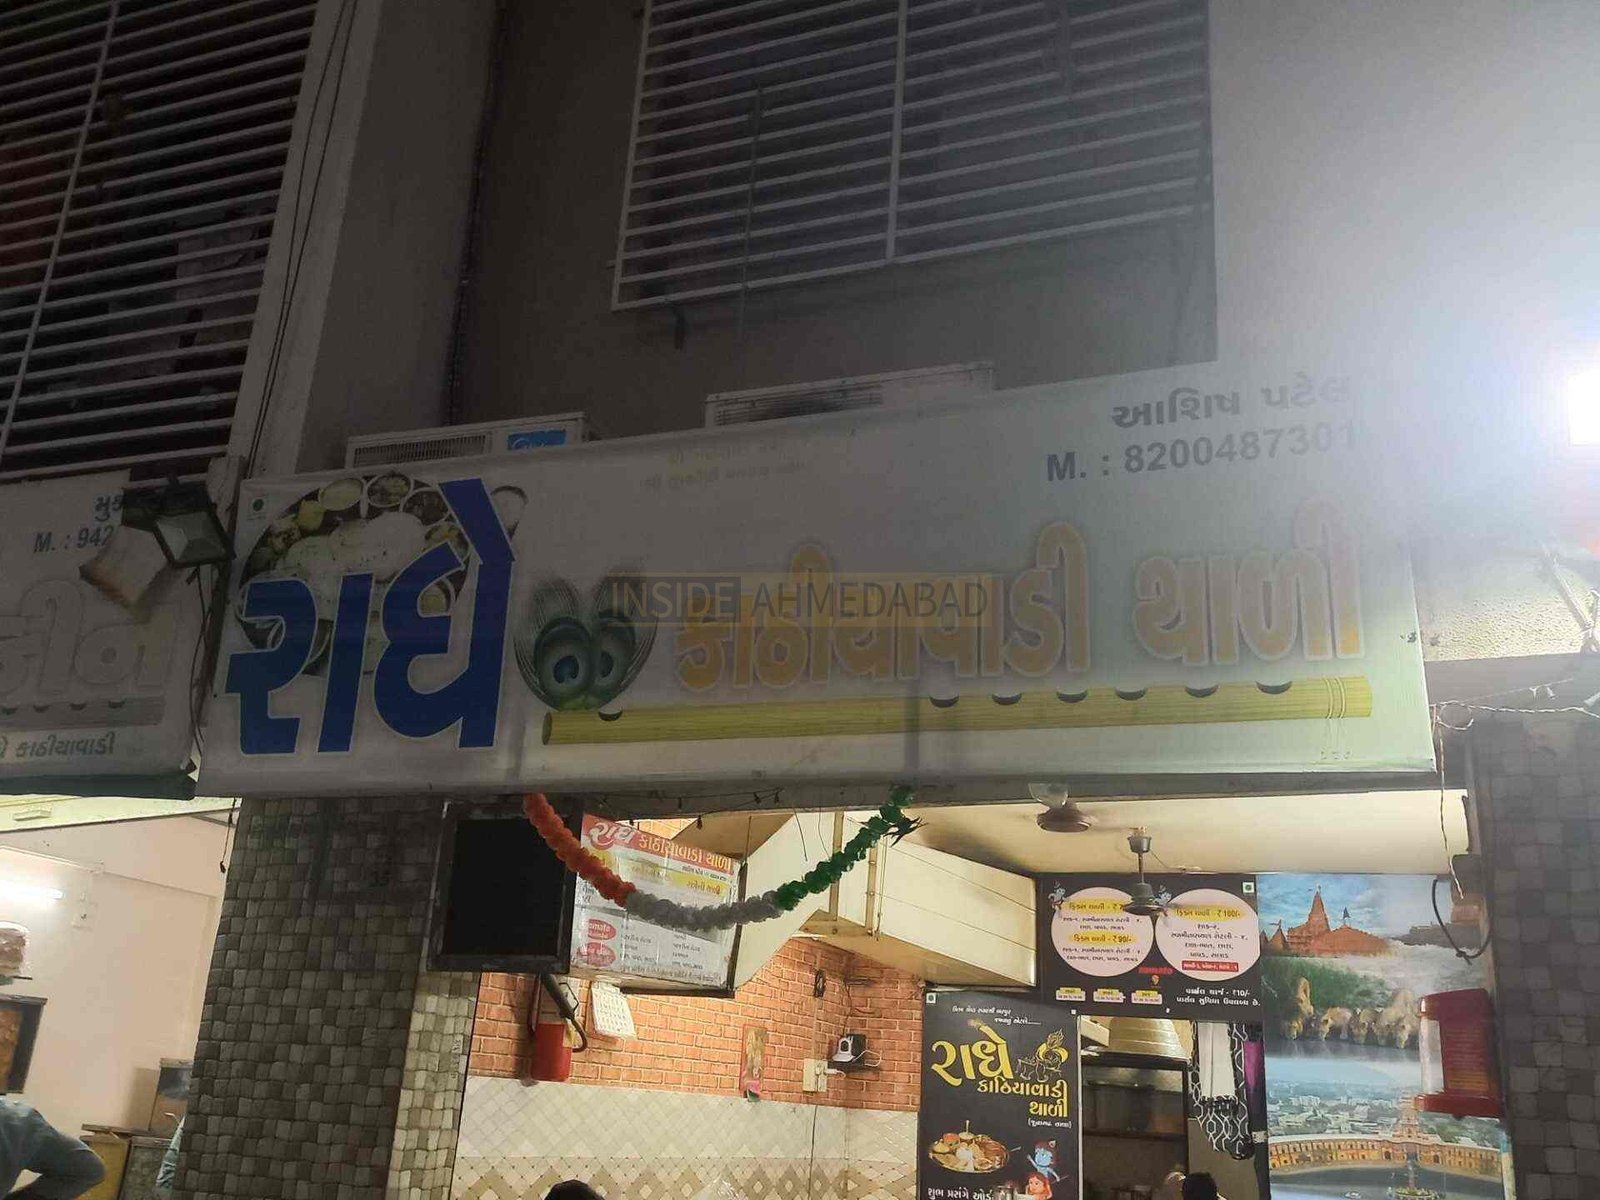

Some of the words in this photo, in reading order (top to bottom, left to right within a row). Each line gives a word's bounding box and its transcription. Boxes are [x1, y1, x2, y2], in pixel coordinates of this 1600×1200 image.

[1047, 451, 1087, 481] M.
[1124, 419, 1355, 473] 8200487301
[225, 478, 515, 754] રાધે
[674, 520, 1090, 691] કાઠીયાવાડી
[1133, 499, 1365, 667] થાળી
[16, 731, 115, 758] કાઠીયાવાડી
[931, 1025, 1013, 1086] રાધે
[977, 1079, 1068, 1098] કાઠિયાવાડી
[1029, 1098, 1068, 1118] થાળી
